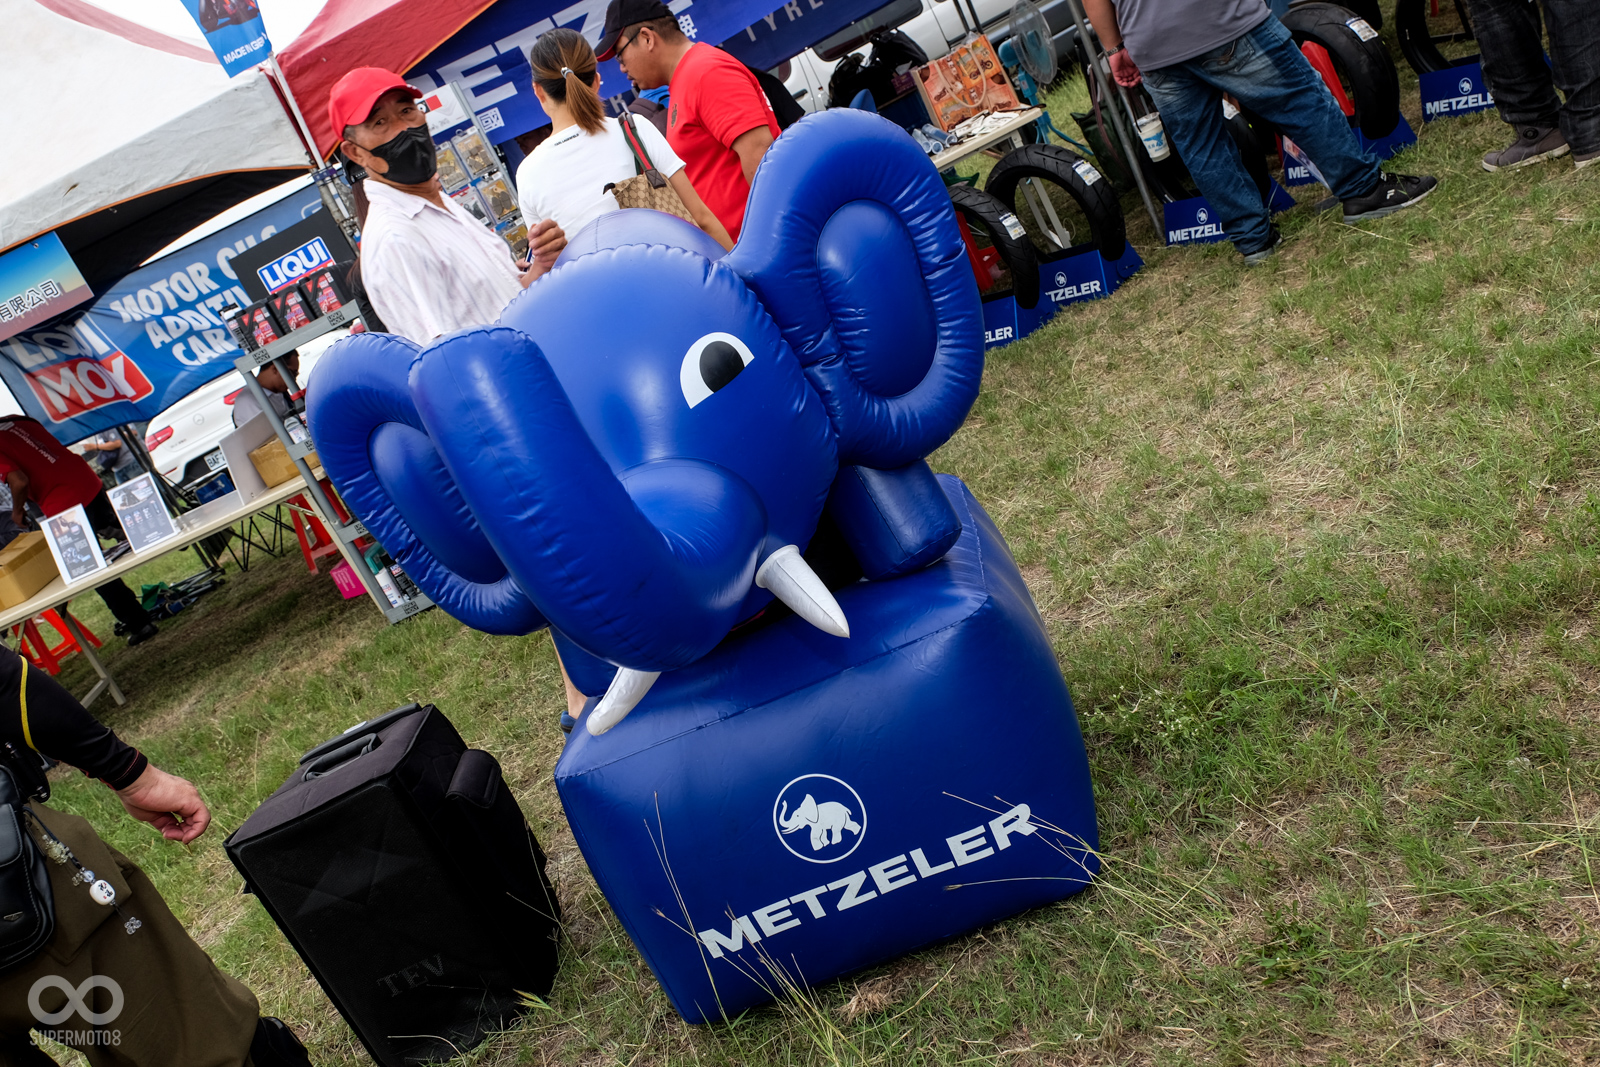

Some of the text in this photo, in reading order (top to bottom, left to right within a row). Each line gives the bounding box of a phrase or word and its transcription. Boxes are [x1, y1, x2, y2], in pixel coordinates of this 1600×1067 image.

[261, 240, 328, 289] LIQUI
[0, 279, 60, 322] 有限公司
[109, 262, 221, 323] MOTOR
[172, 328, 238, 367] CAR
[698, 803, 1039, 958] METZELER
